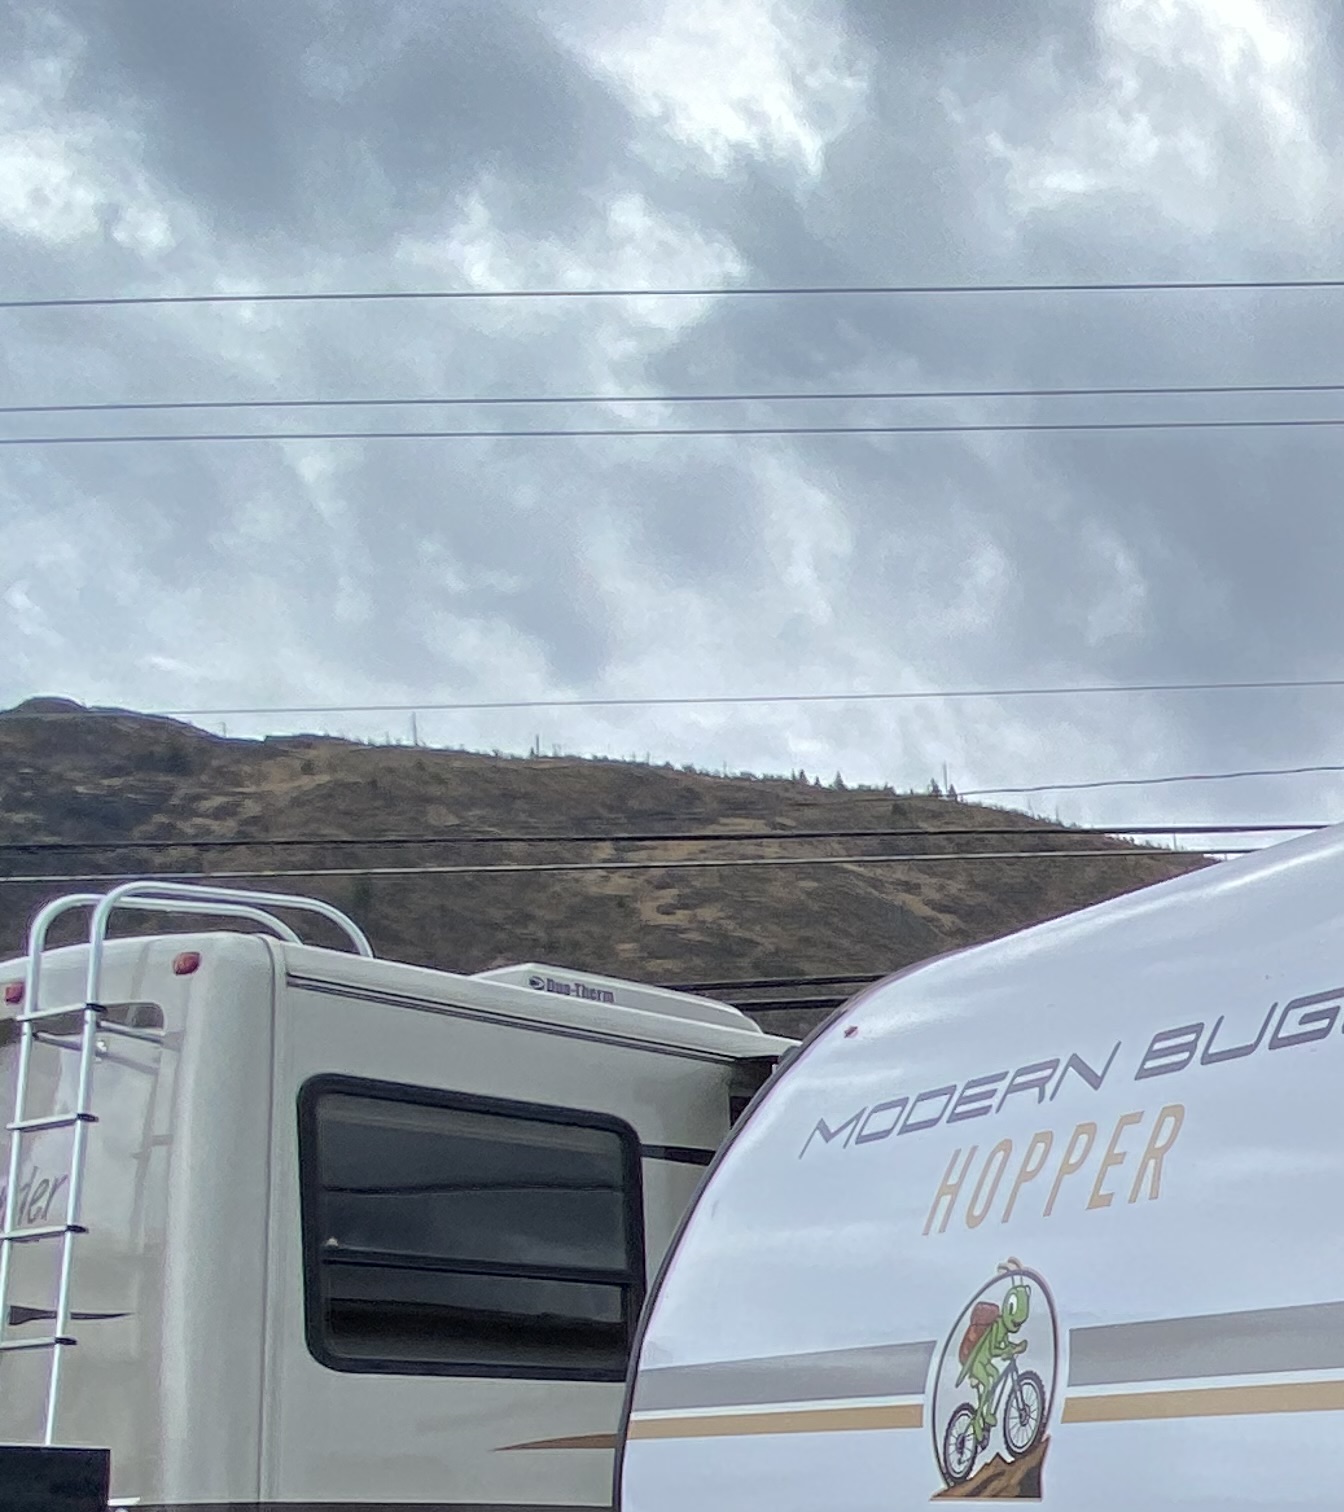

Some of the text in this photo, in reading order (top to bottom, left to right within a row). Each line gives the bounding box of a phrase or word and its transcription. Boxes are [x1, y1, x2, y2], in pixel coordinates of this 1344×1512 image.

[546, 977, 615, 1003] Duo-Therm
[798, 1040, 1122, 1159] MODERN
[922, 1103, 1186, 1236] HOPPER
